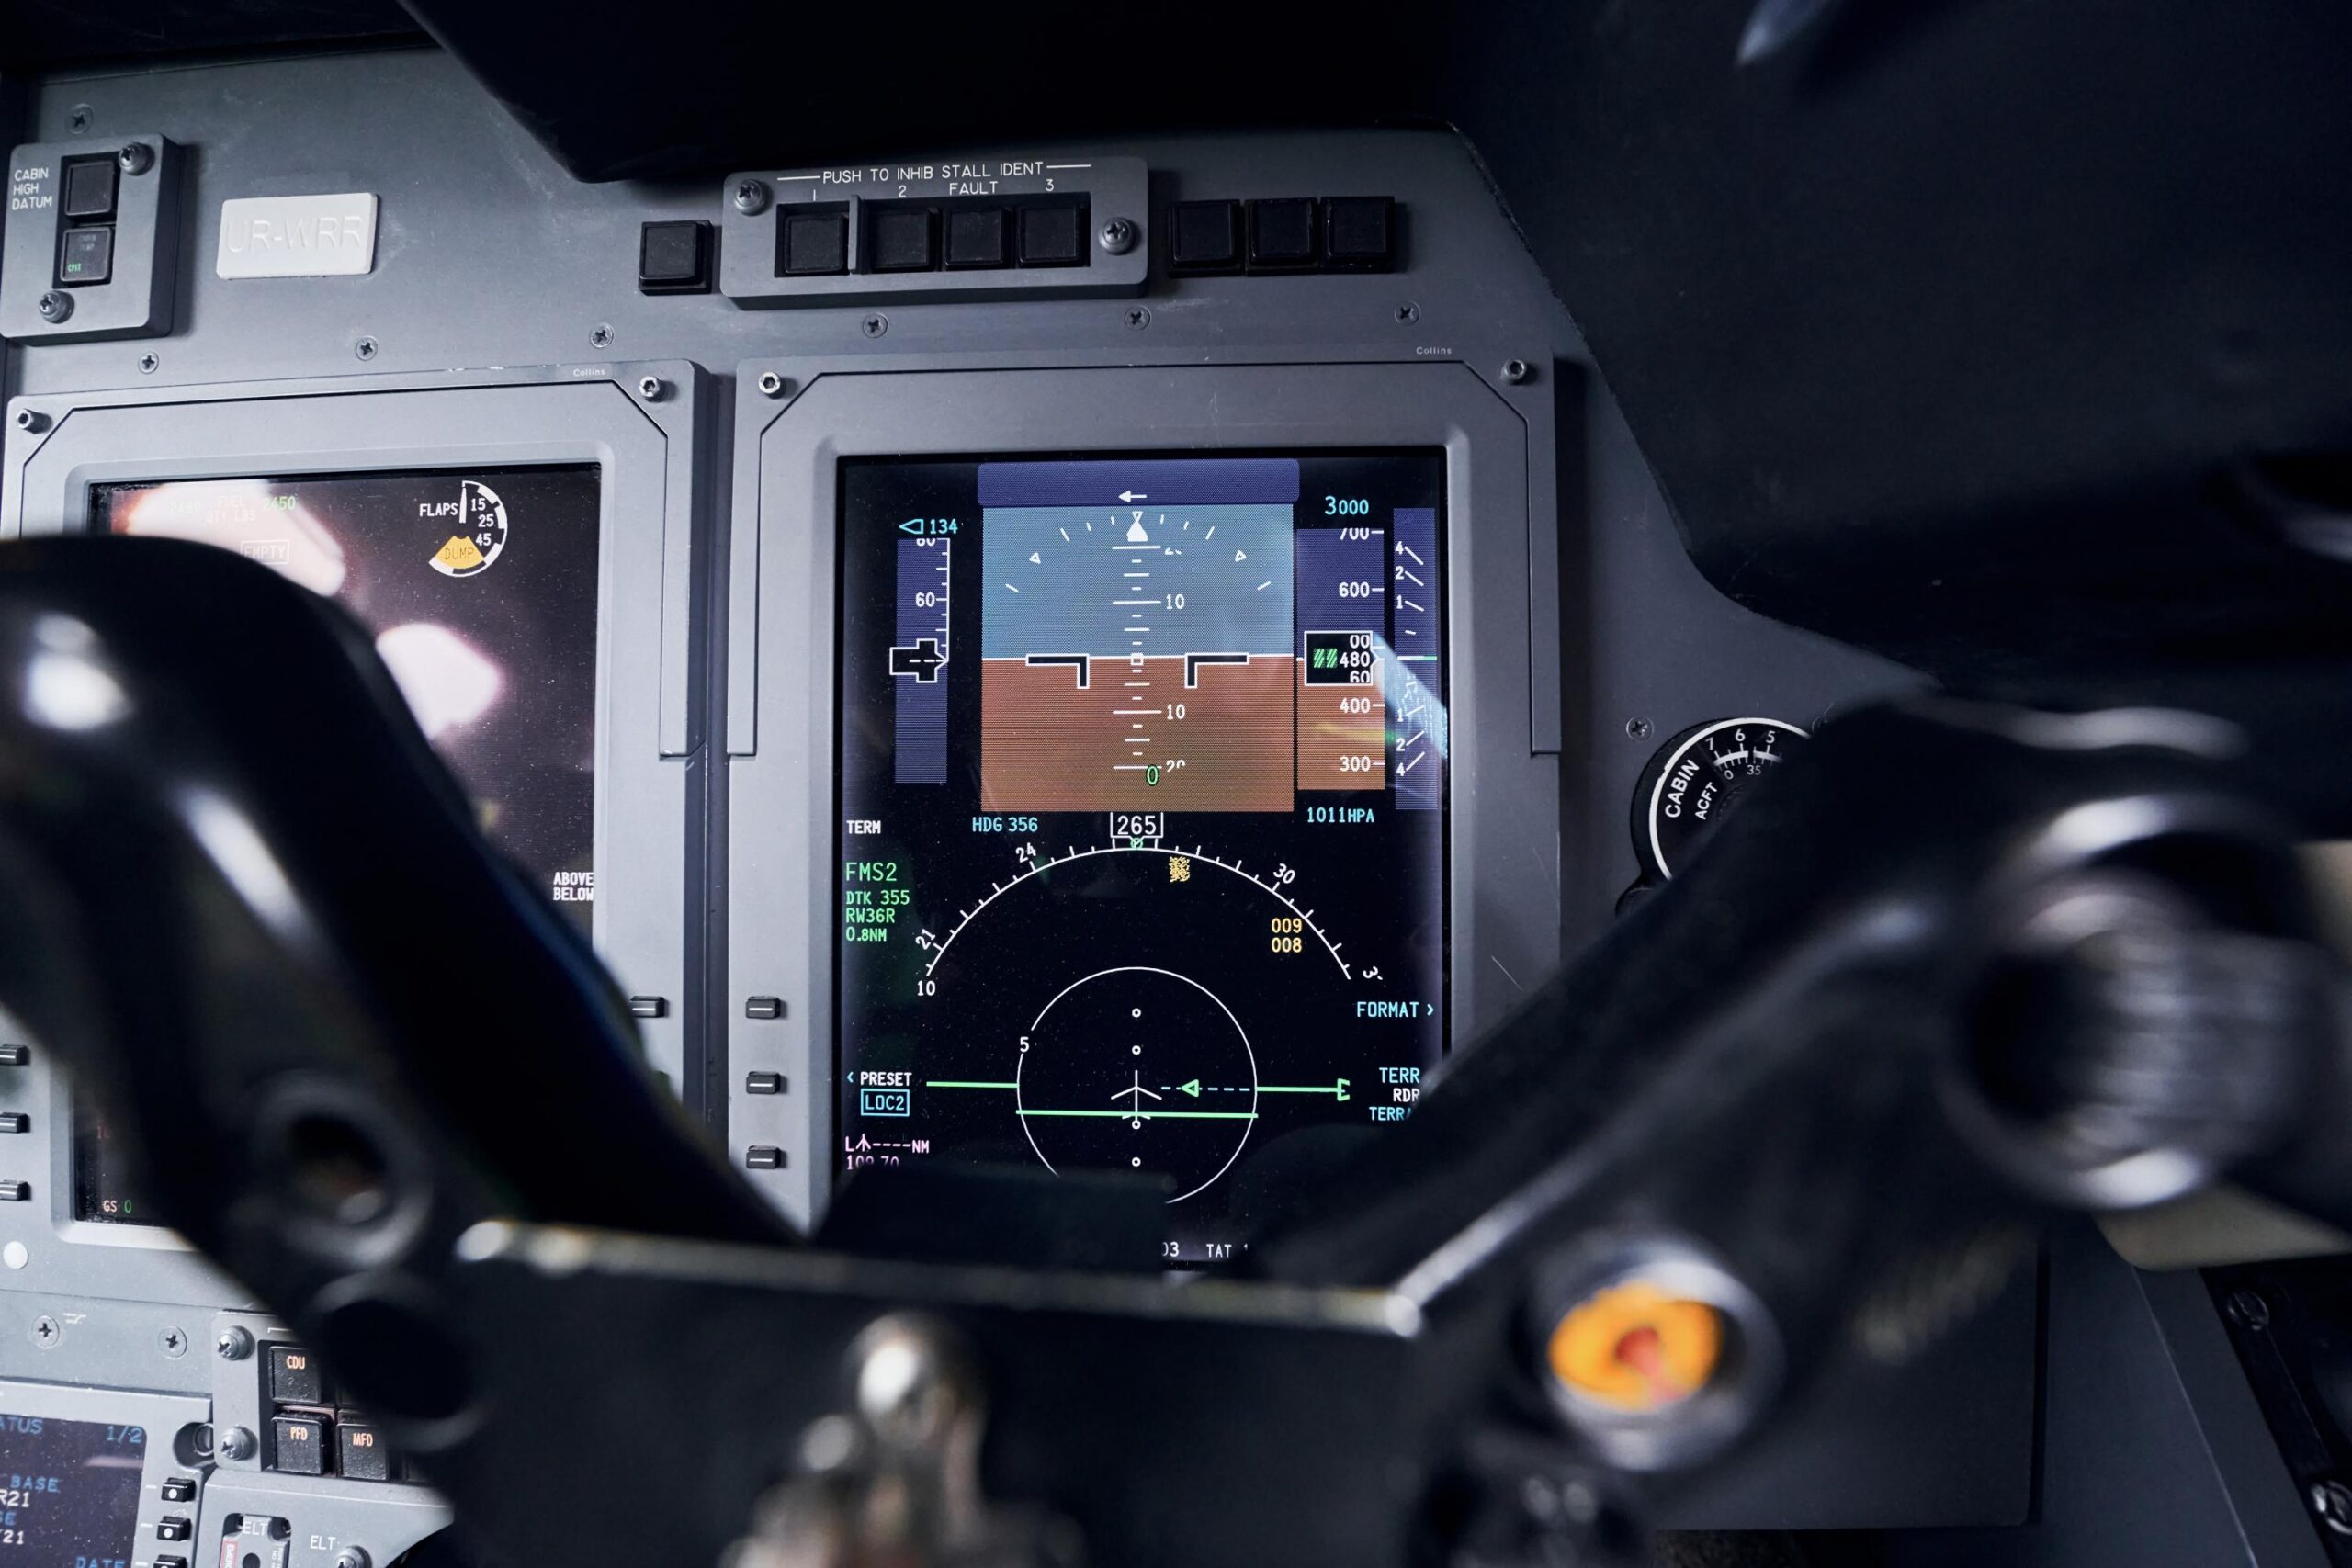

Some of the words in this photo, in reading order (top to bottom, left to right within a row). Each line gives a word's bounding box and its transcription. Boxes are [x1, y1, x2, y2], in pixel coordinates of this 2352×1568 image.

[14, 168, 49, 181] CABIN
[822, 170, 860, 184] PUSH
[870, 169, 889, 181] TO
[897, 165, 933, 180] INHIB
[941, 164, 991, 178] STALL
[1000, 162, 1044, 176] IDENT
[13, 184, 39, 196] HIGH
[812, 189, 816, 201] 1
[898, 186, 907, 198] 2
[949, 182, 998, 196] FAULT
[1046, 179, 1054, 193] 3
[11, 196, 52, 210] DATUM
[225, 215, 363, 254] UR-WRR
[1416, 346, 1452, 355] Collins
[572, 368, 605, 377] Collins
[419, 503, 458, 517] FLAPS
[470, 498, 486, 512] 15
[1324, 495, 1369, 515] 3000
[478, 513, 494, 527] 25
[930, 519, 958, 534] 134
[475, 533, 492, 547] 45
[444, 547, 475, 560] DUMP
[1395, 541, 1404, 555] 4
[1395, 566, 1404, 580] 2
[1339, 582, 1370, 597] 600
[915, 592, 935, 607] 60
[1165, 594, 1184, 609] 10
[1396, 595, 1403, 609] 1
[1167, 704, 1185, 719] 10
[1340, 698, 1371, 713] 400
[1396, 708, 1403, 722] 1
[1735, 728, 1746, 741] 6
[1766, 730, 1776, 744] 5
[1396, 739, 1405, 751] 2
[1705, 737, 1716, 750] 7
[1340, 756, 1370, 772] 300
[1396, 763, 1405, 776] 4
[1747, 764, 1762, 775] 35
[1147, 765, 1158, 785] 0
[1724, 770, 1734, 780] 0
[1665, 759, 1700, 818] CABIN
[1695, 782, 1718, 820] ACFT
[1307, 807, 1374, 823] 1011HPA
[846, 820, 881, 834] TERM
[972, 817, 1002, 832] HDG
[1008, 817, 1038, 832] 356
[1117, 816, 1156, 835] 265
[1015, 842, 1036, 863] 24
[553, 871, 594, 886] ABOVE
[845, 863, 898, 881] FMS2
[1272, 863, 1295, 885] 30
[553, 886, 594, 901] BELOW
[845, 891, 872, 905] DTK
[880, 890, 910, 905] 355
[845, 908, 895, 923] RW36R
[1271, 918, 1302, 933] 009
[845, 928, 887, 942] 0.8NM
[915, 929, 935, 950] 21
[1271, 938, 1302, 953] 008
[917, 980, 935, 996] 10
[1357, 1002, 1419, 1017] FORMAT
[1020, 1036, 1029, 1053] 5
[860, 1072, 912, 1087] PRESET
[1379, 1067, 1420, 1084] TERR
[1393, 1088, 1420, 1102] RDR
[865, 1096, 905, 1111] LOC2
[103, 1200, 118, 1213] GS
[124, 1200, 132, 1213] 0
[1205, 1243, 1232, 1258] TAT
[286, 1356, 305, 1370] CDU
[106, 1425, 143, 1444] 1/2
[290, 1427, 308, 1441] PFD
[353, 1433, 373, 1447] MFD
[10, 1474, 60, 1493] BASE
[243, 1520, 268, 1536] ELT
[310, 1535, 336, 1551] ELT
